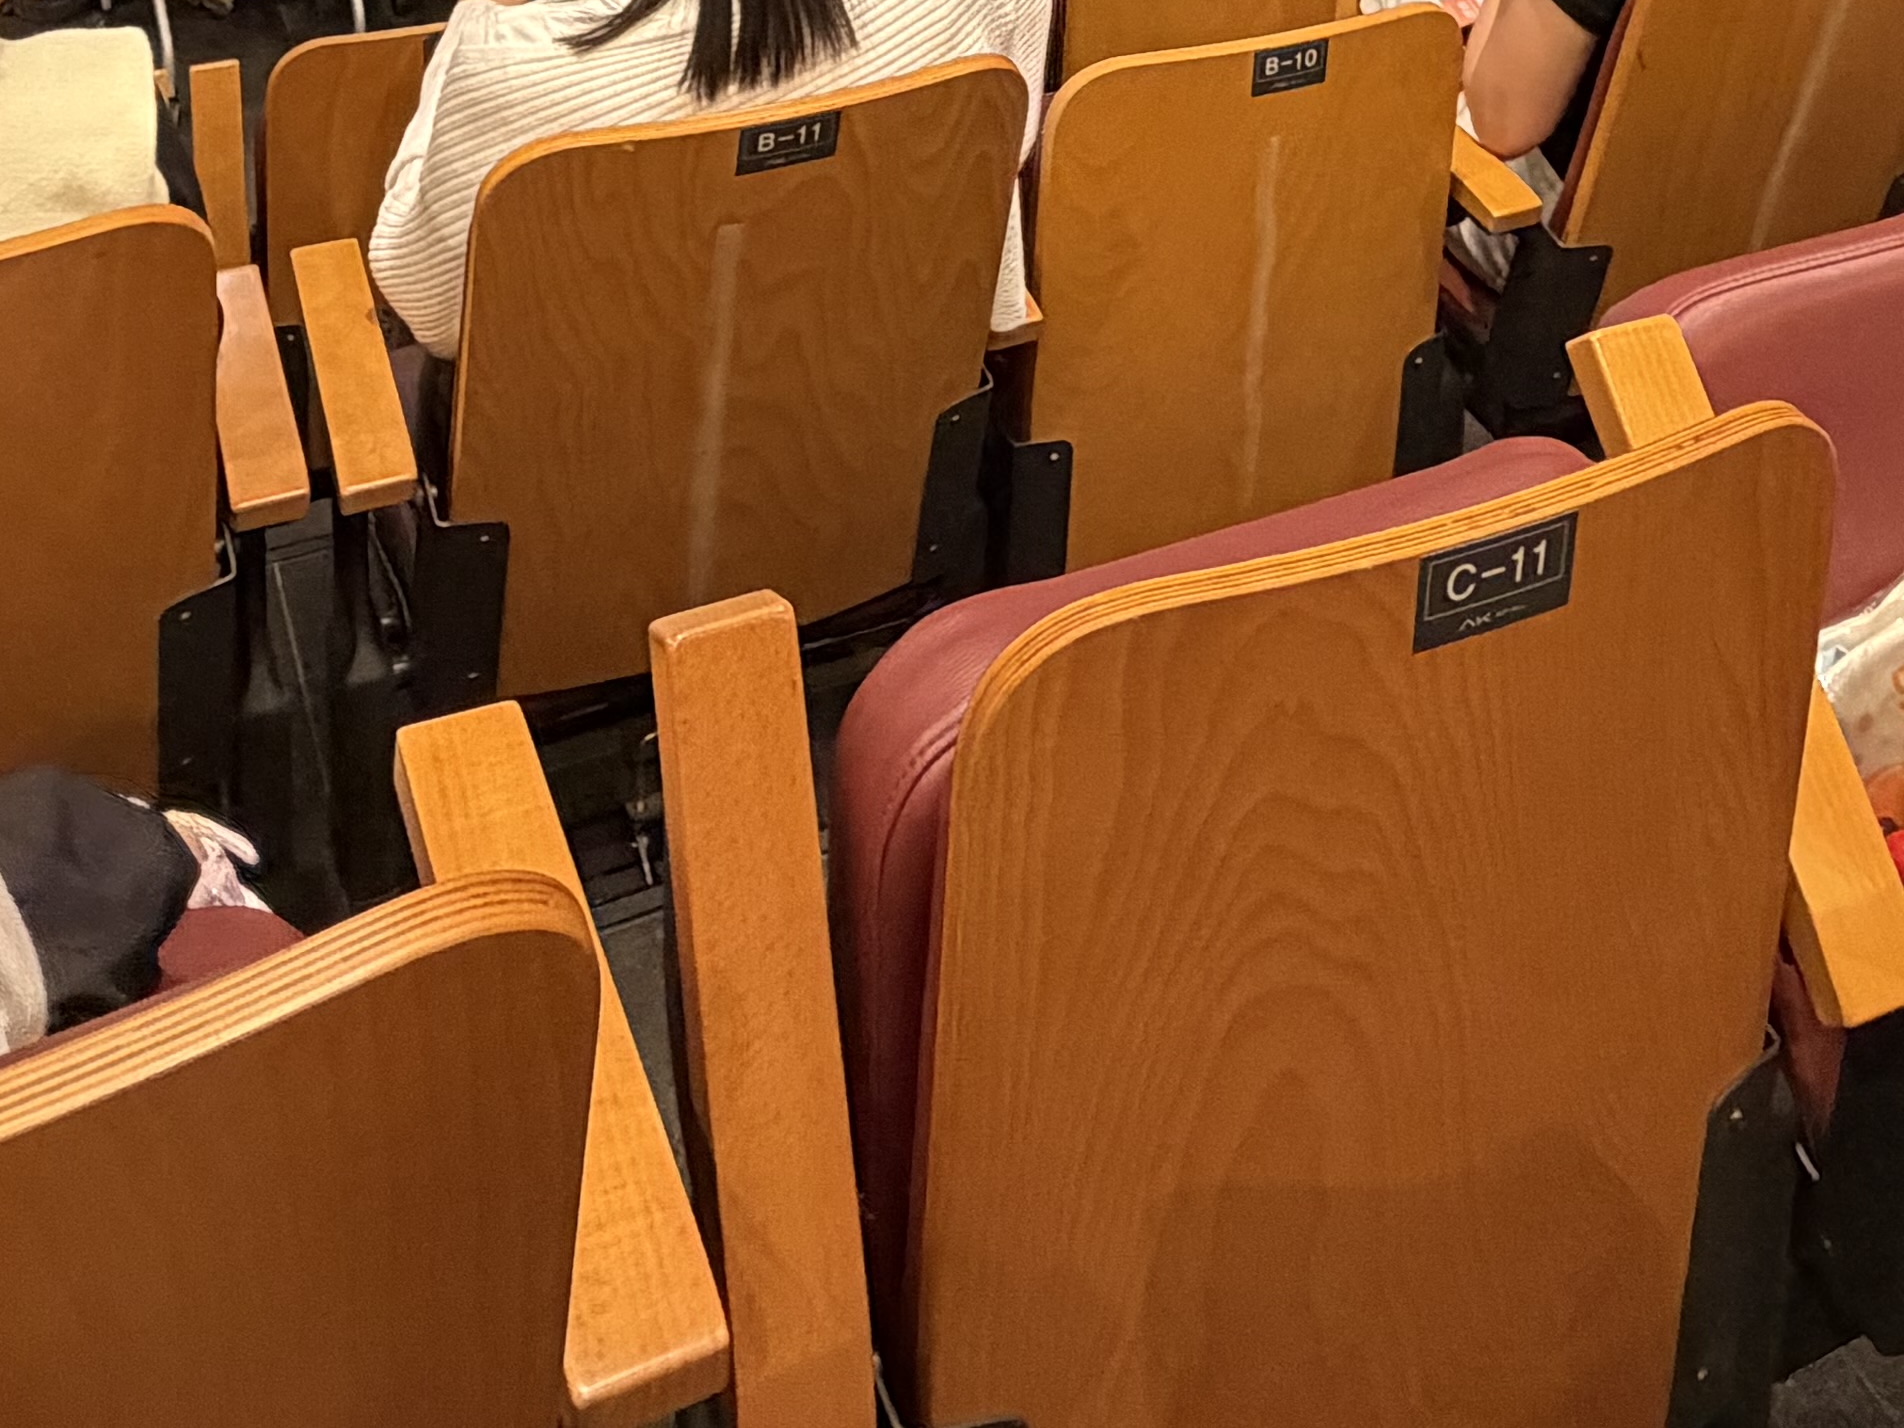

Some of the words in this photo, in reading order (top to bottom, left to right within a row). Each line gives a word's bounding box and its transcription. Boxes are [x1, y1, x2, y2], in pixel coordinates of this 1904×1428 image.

[1265, 48, 1317, 77] B-10
[757, 122, 822, 153] B-11
[1447, 539, 1546, 601] C-11
